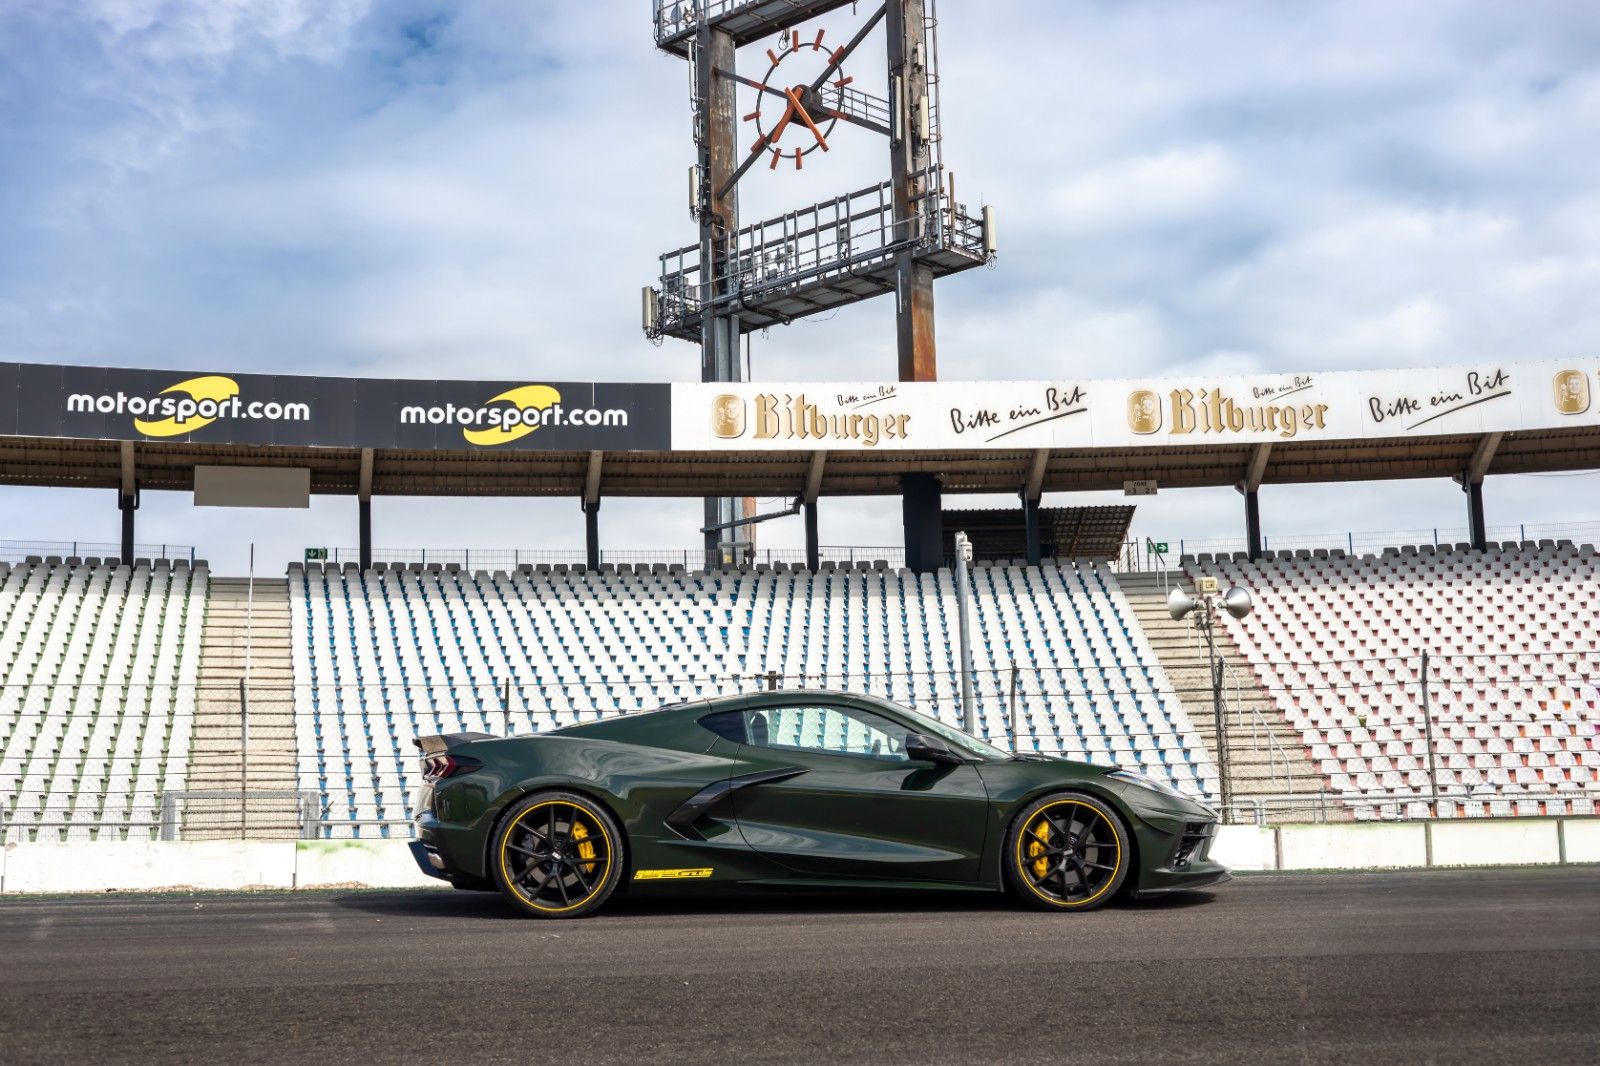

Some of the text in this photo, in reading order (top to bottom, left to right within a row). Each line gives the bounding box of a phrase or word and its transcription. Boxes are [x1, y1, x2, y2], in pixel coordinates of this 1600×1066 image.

[67, 391, 310, 422] motorsport.com
[837, 394, 859, 406] Bitte
[879, 385, 897, 397] Bit
[1253, 387, 1275, 398] Bitte
[1294, 376, 1312, 387] Bit
[1369, 369, 1510, 422] Bitte ein Bit
[400, 403, 628, 431] motorsport.com
[752, 393, 912, 446] Bitburger
[950, 386, 1087, 434] Bitte ein Bit
[1168, 387, 1329, 438] Bitburger
